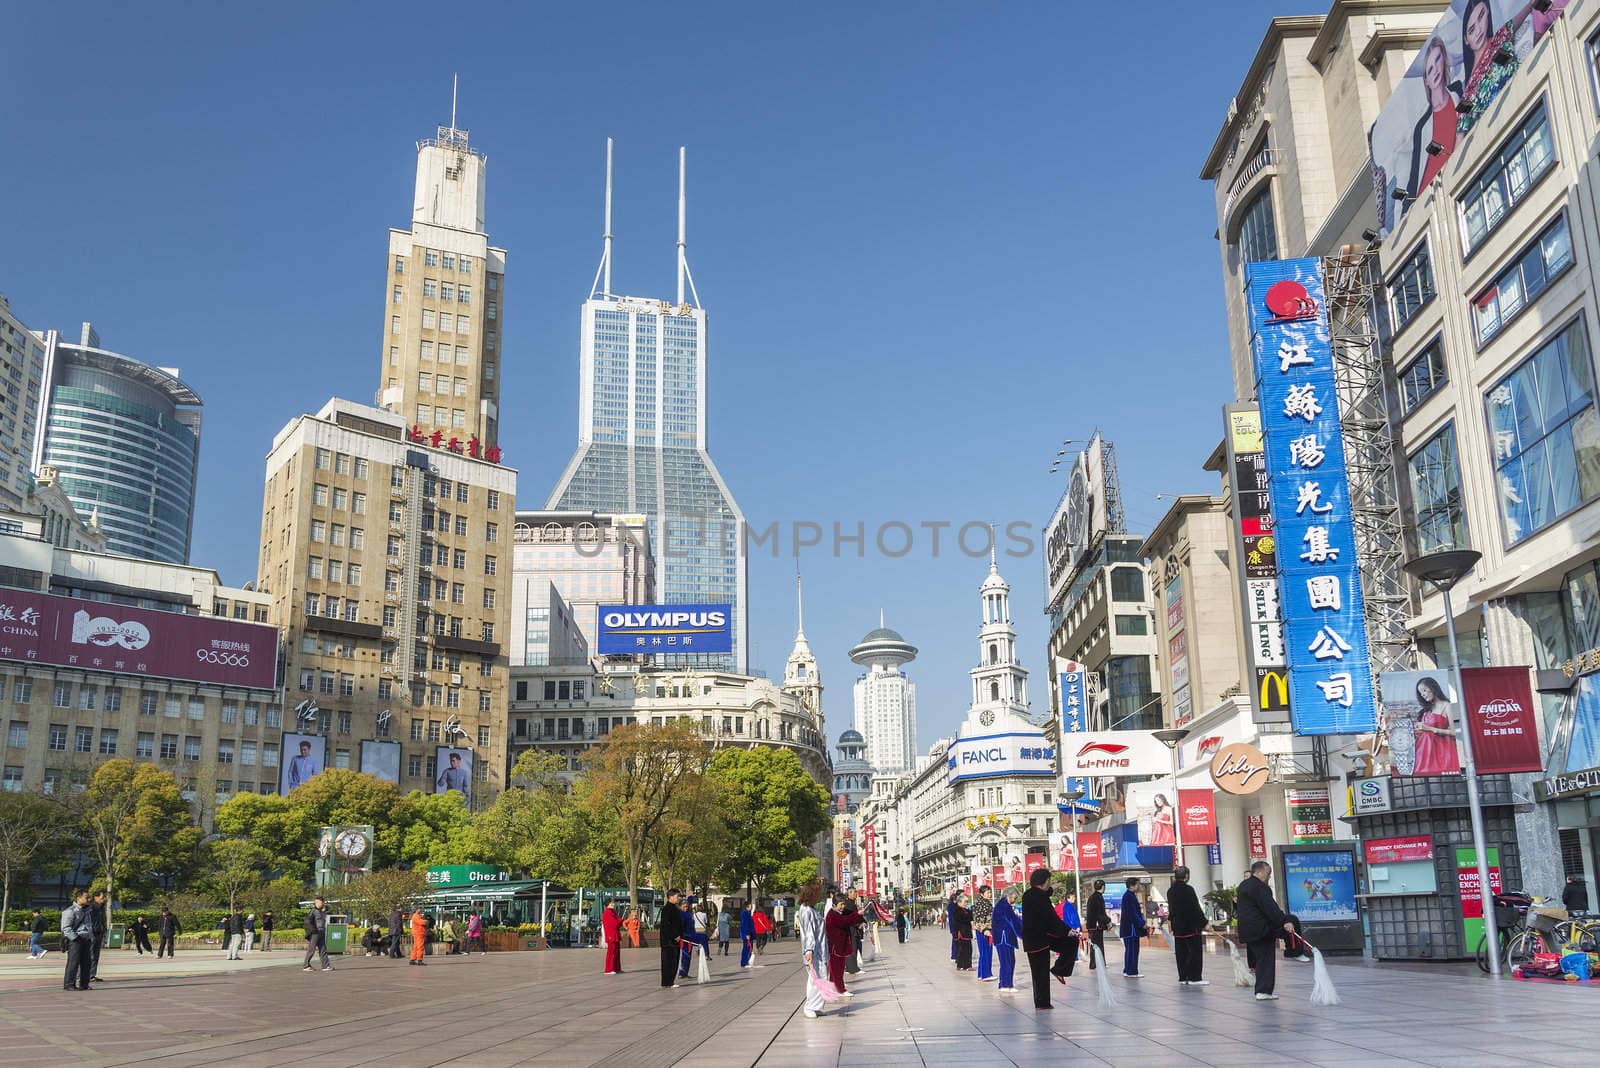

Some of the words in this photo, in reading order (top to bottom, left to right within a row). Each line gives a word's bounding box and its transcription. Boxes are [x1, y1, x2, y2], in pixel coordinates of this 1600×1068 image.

[1256, 589, 1266, 619] SILK
[604, 612, 726, 628] OLYMPUS
[3, 626, 39, 637] CHINA
[636, 636, 693, 646] 奥林巴斯
[1259, 624, 1271, 658] KING
[197, 649, 249, 667] 95566
[1478, 703, 1523, 713] ENICAR
[963, 747, 1007, 764] FANCL
[1216, 753, 1269, 785] Lily
[469, 871, 496, 881] Chez
[1459, 872, 1499, 880] CURRCY
[1460, 880, 1500, 888] EXCHGE
